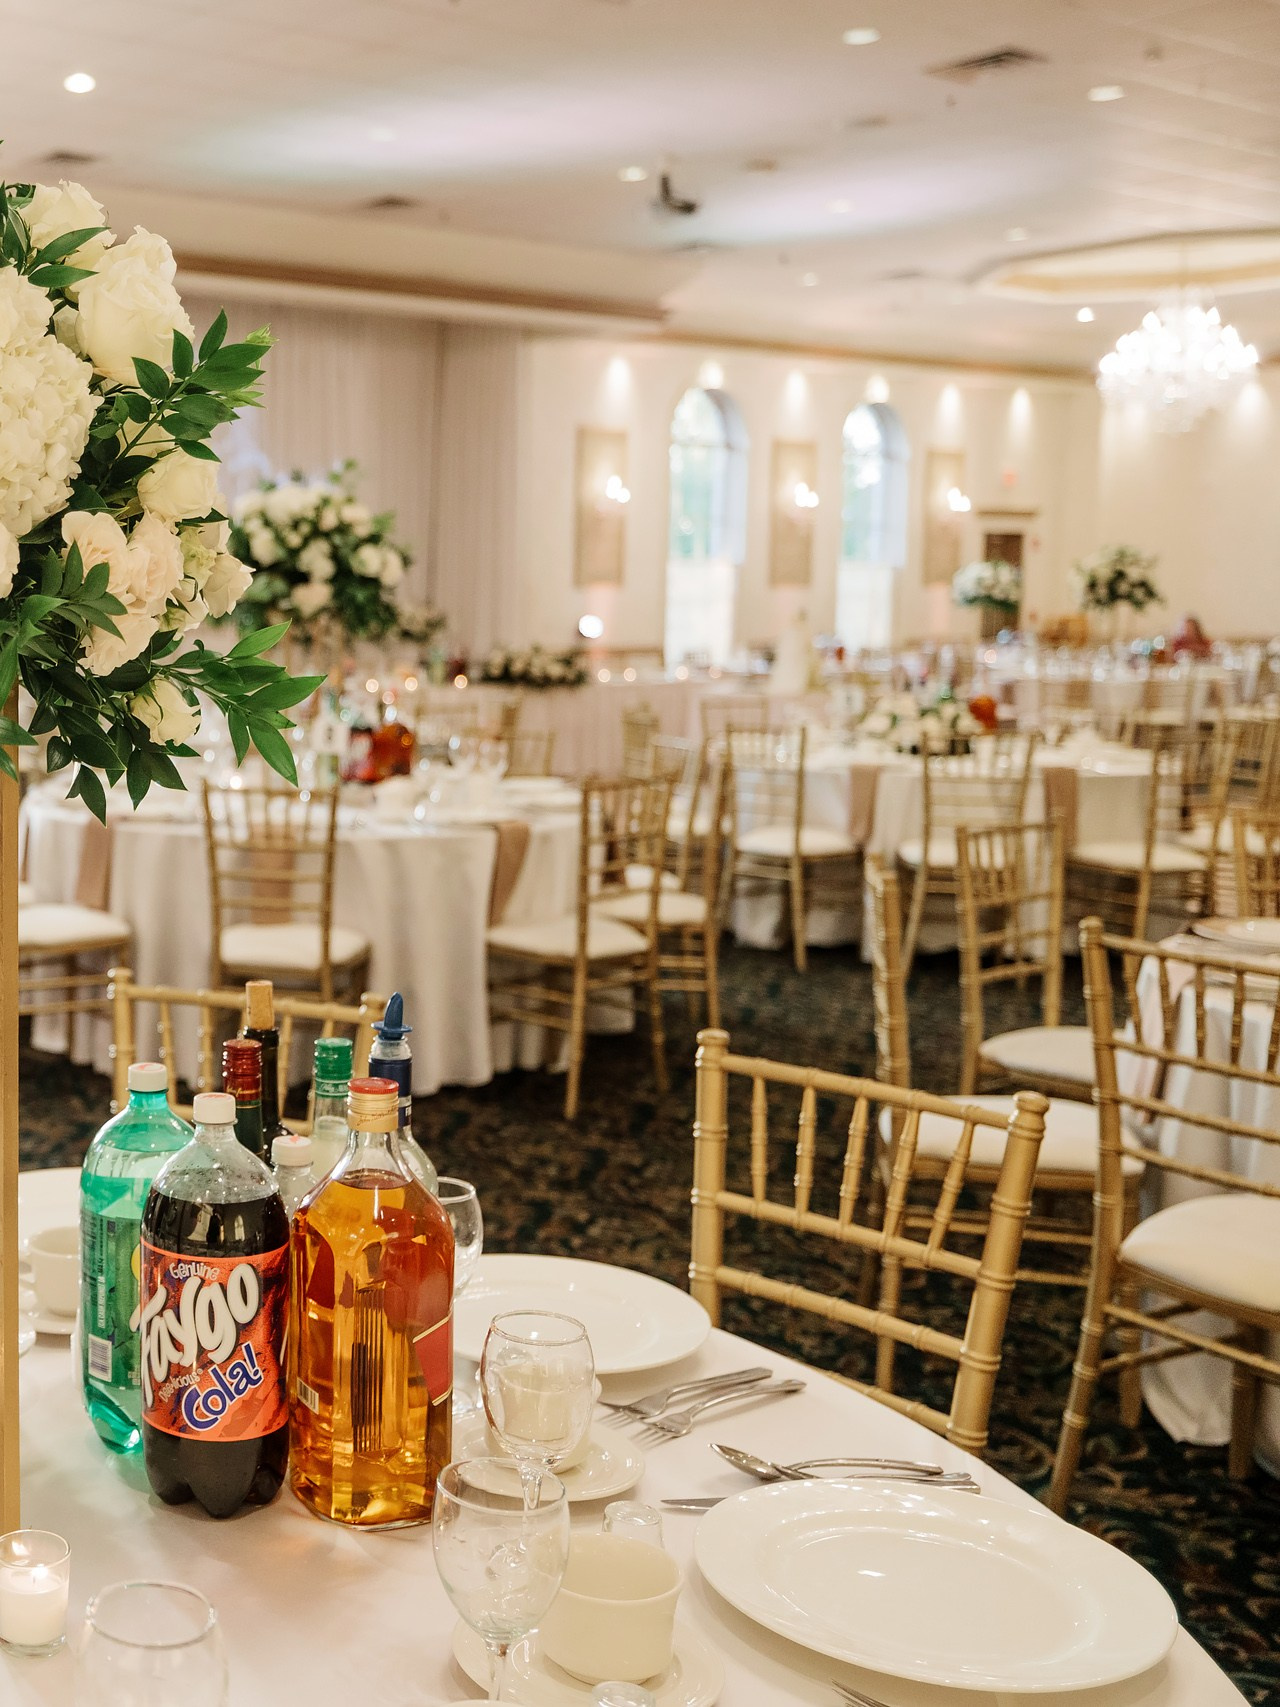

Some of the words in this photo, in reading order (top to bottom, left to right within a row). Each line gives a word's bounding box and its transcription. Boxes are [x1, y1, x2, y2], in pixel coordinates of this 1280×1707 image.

[169, 1261, 220, 1281] Genuine
[140, 1263, 260, 1408] Faygo
[181, 1341, 264, 1432] Cola!
